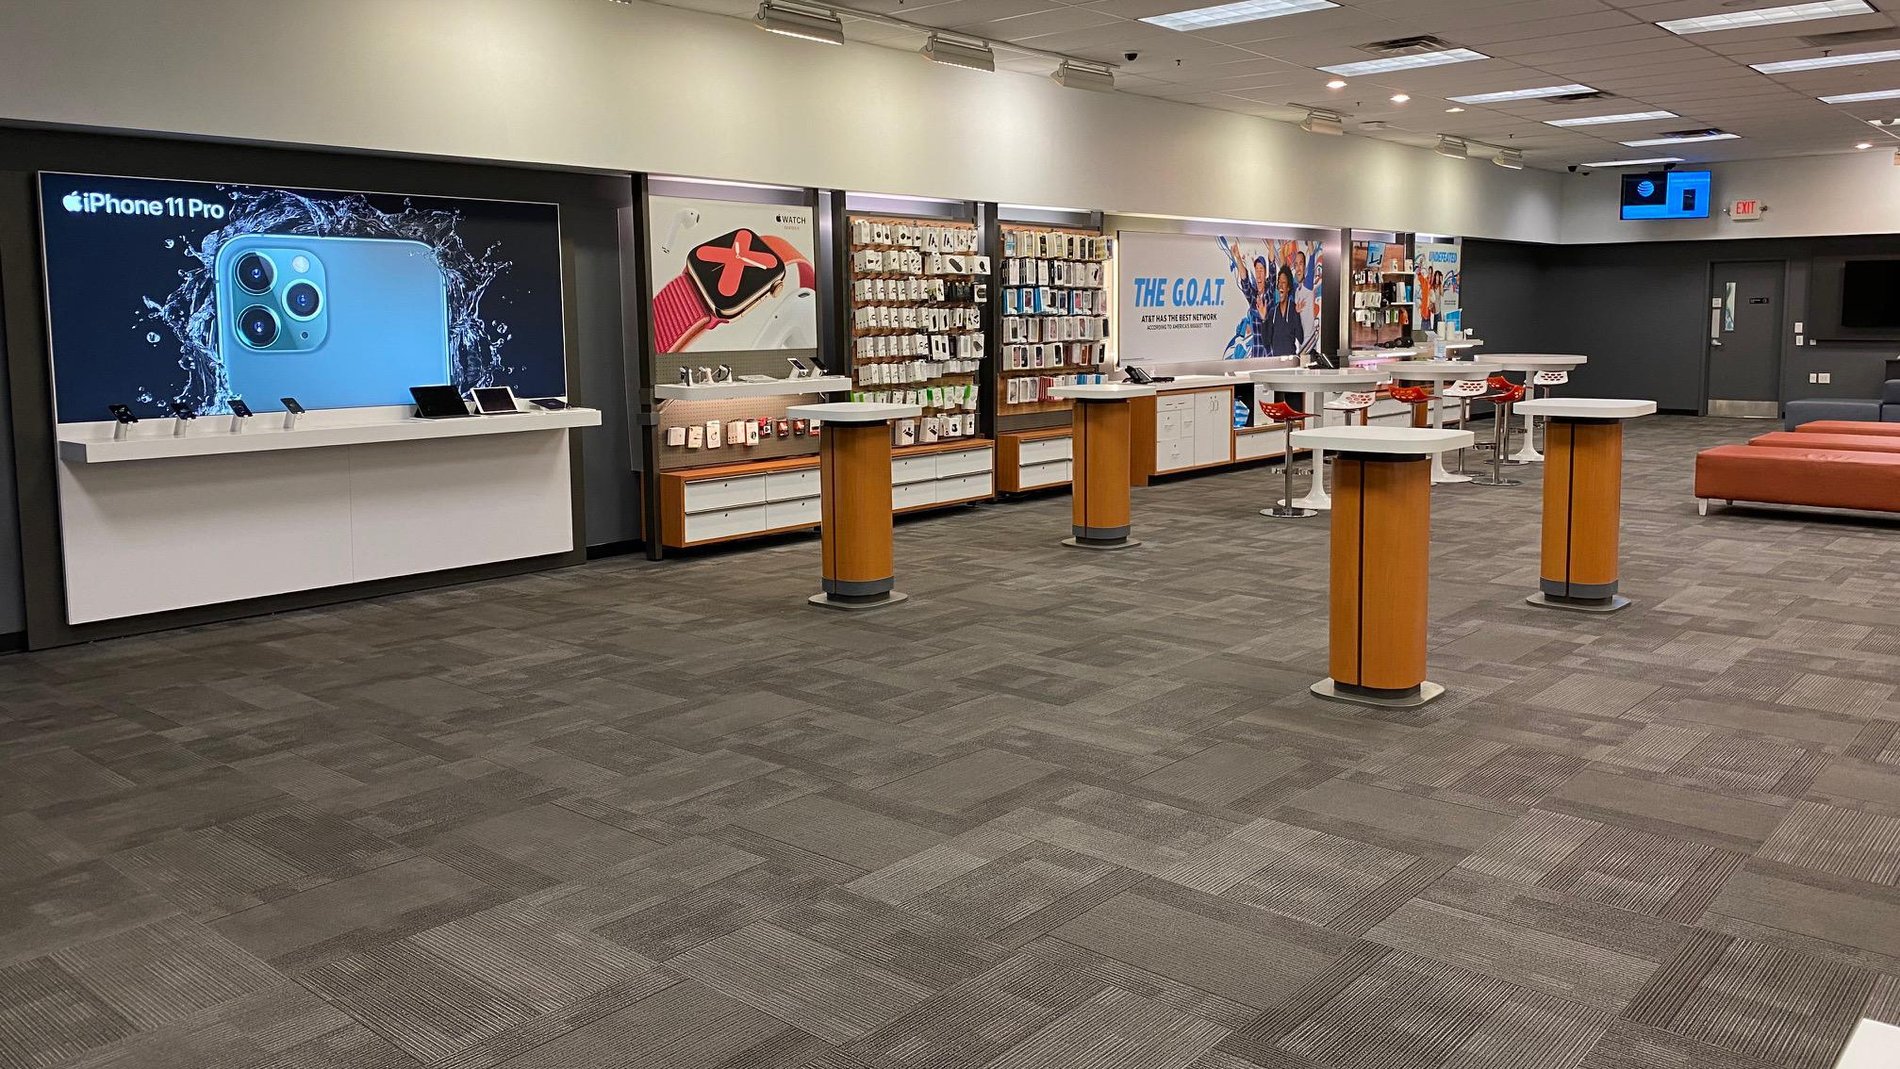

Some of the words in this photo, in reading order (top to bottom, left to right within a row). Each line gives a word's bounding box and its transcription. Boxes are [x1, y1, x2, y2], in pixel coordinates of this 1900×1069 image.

[83, 192, 163, 216] iPhone
[165, 197, 185, 217] 11
[188, 198, 225, 219] Pro
[1736, 200, 1756, 215] EXIT
[782, 216, 806, 224] WATCH
[1134, 278, 1168, 307] THE
[1172, 278, 1224, 306] G.O.A.T.
[1141, 315, 1156, 323] AT&T
[1156, 314, 1168, 322] HAS
[1168, 314, 1178, 322] THE
